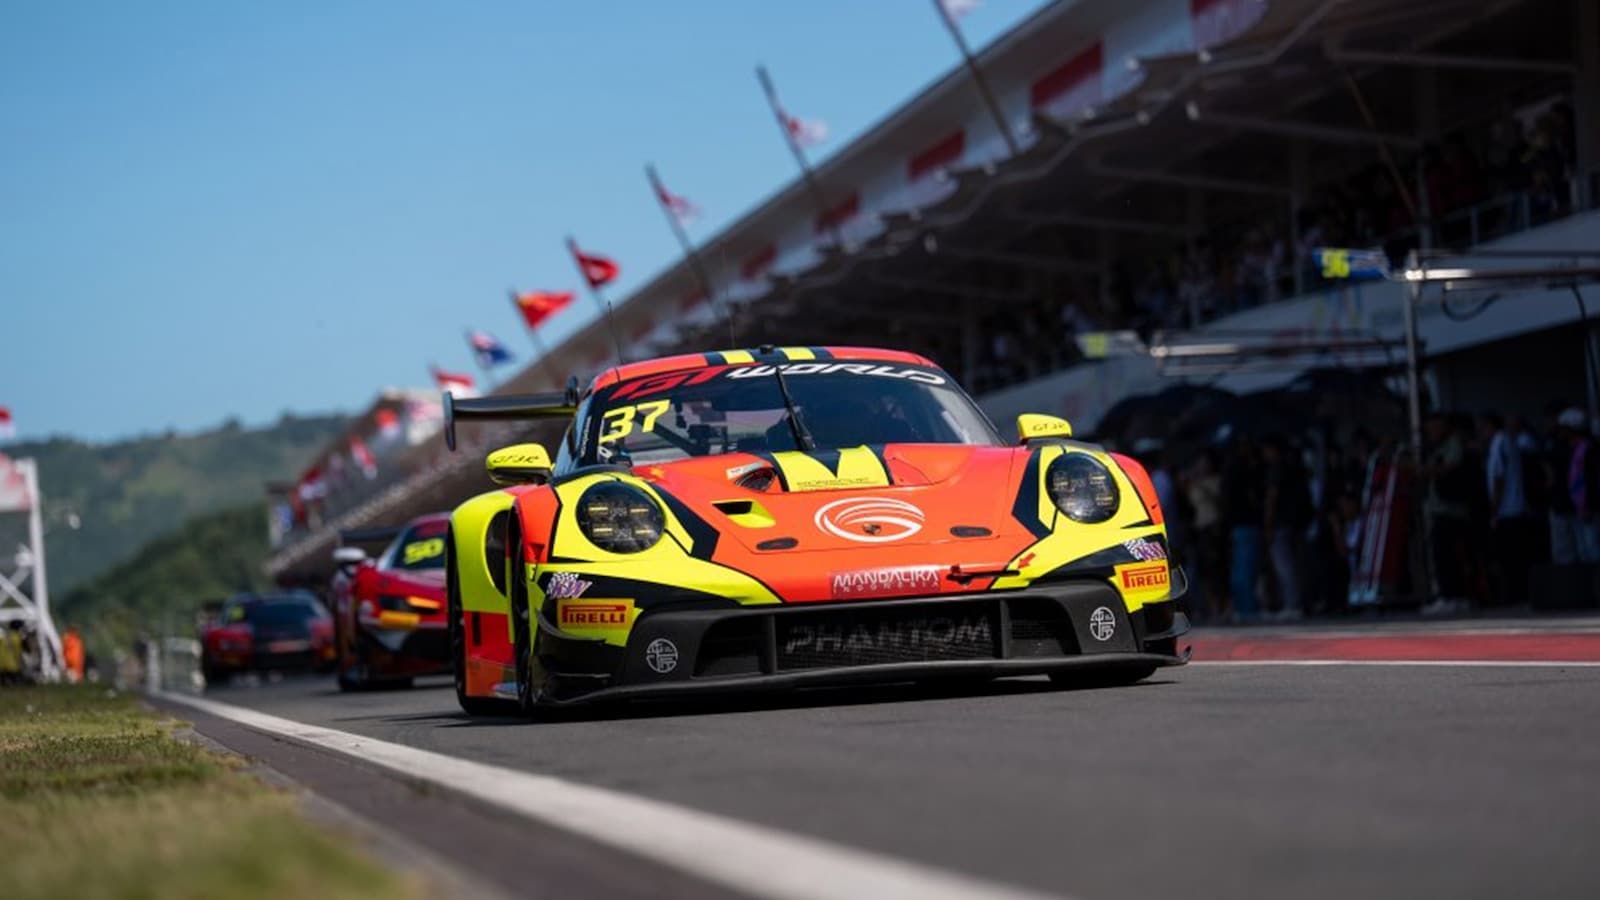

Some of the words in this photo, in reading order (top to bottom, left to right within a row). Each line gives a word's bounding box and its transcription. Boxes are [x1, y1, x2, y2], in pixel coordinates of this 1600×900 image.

[726, 363, 946, 385] WORLD
[599, 400, 671, 444] 37
[832, 567, 940, 587] MANDALIKA
[1121, 566, 1167, 589] PIRELLI
[562, 604, 627, 624] PIRELLI
[785, 617, 991, 653] PHANTOM
